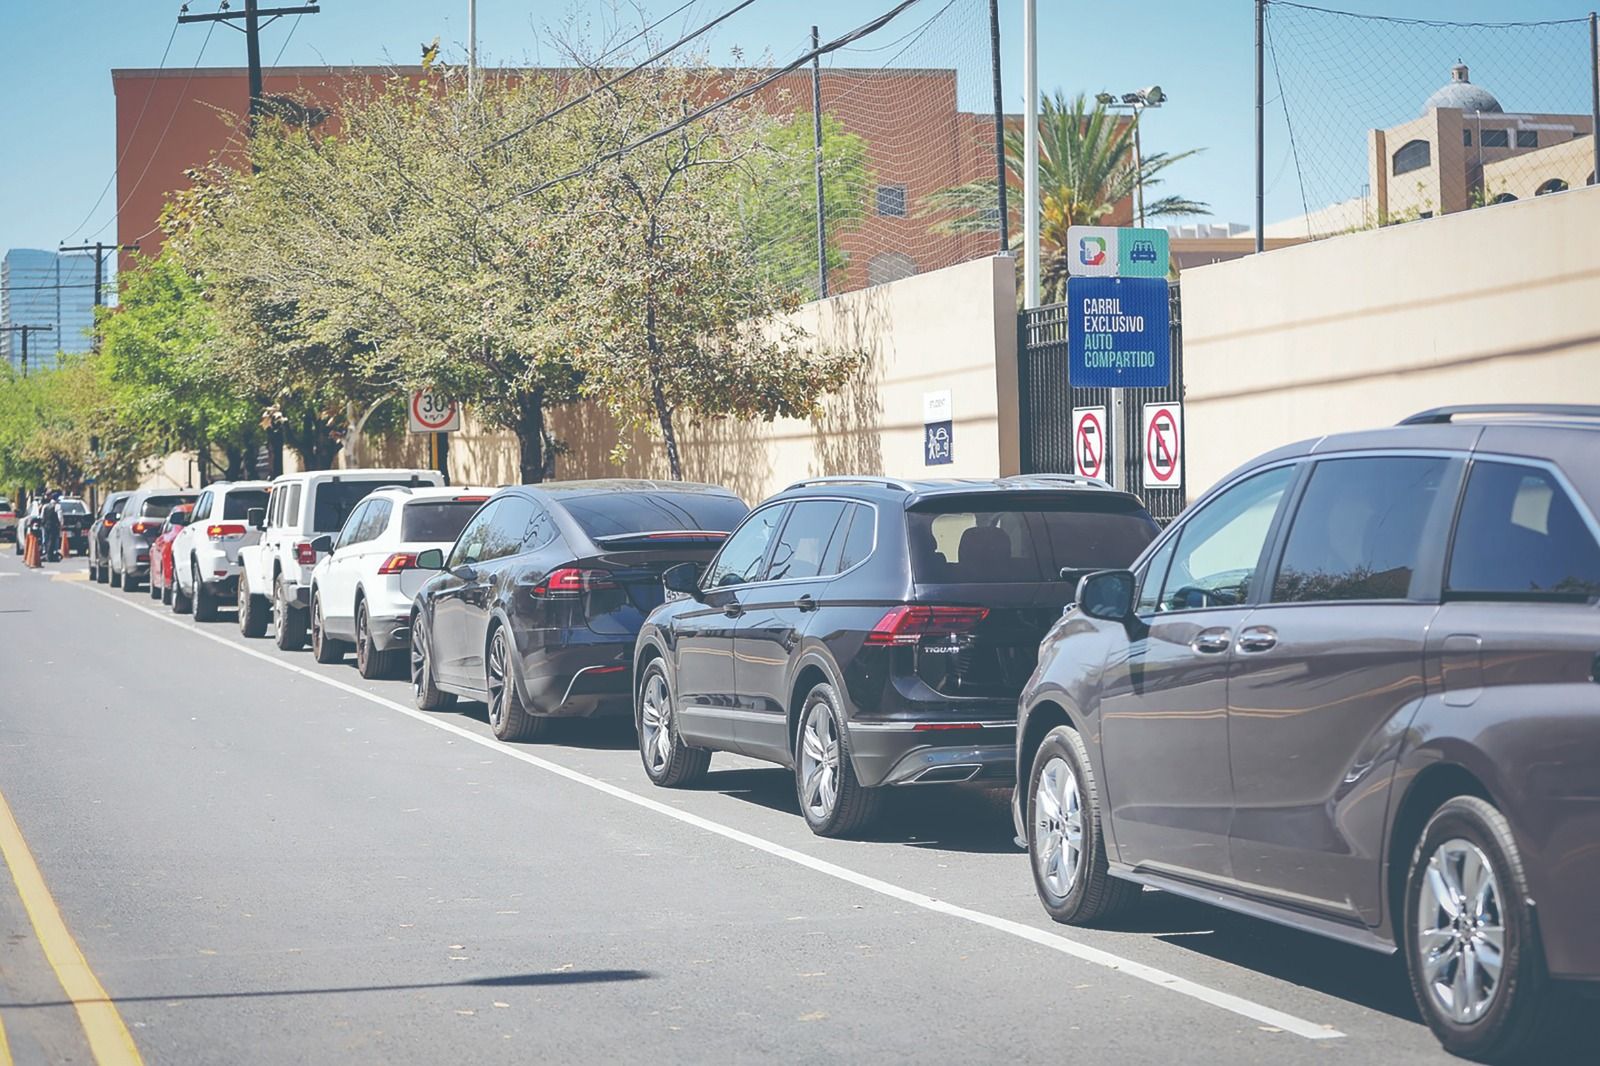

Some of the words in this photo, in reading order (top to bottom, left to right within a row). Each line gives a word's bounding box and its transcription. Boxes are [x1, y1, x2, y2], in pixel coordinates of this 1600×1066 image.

[1083, 298, 1123, 315] CARRIL
[1084, 316, 1144, 333] EXCLUSIVO
[1084, 333, 1113, 350] AUTO
[1084, 351, 1155, 368] COMPARTIDO
[423, 394, 444, 412] 30
